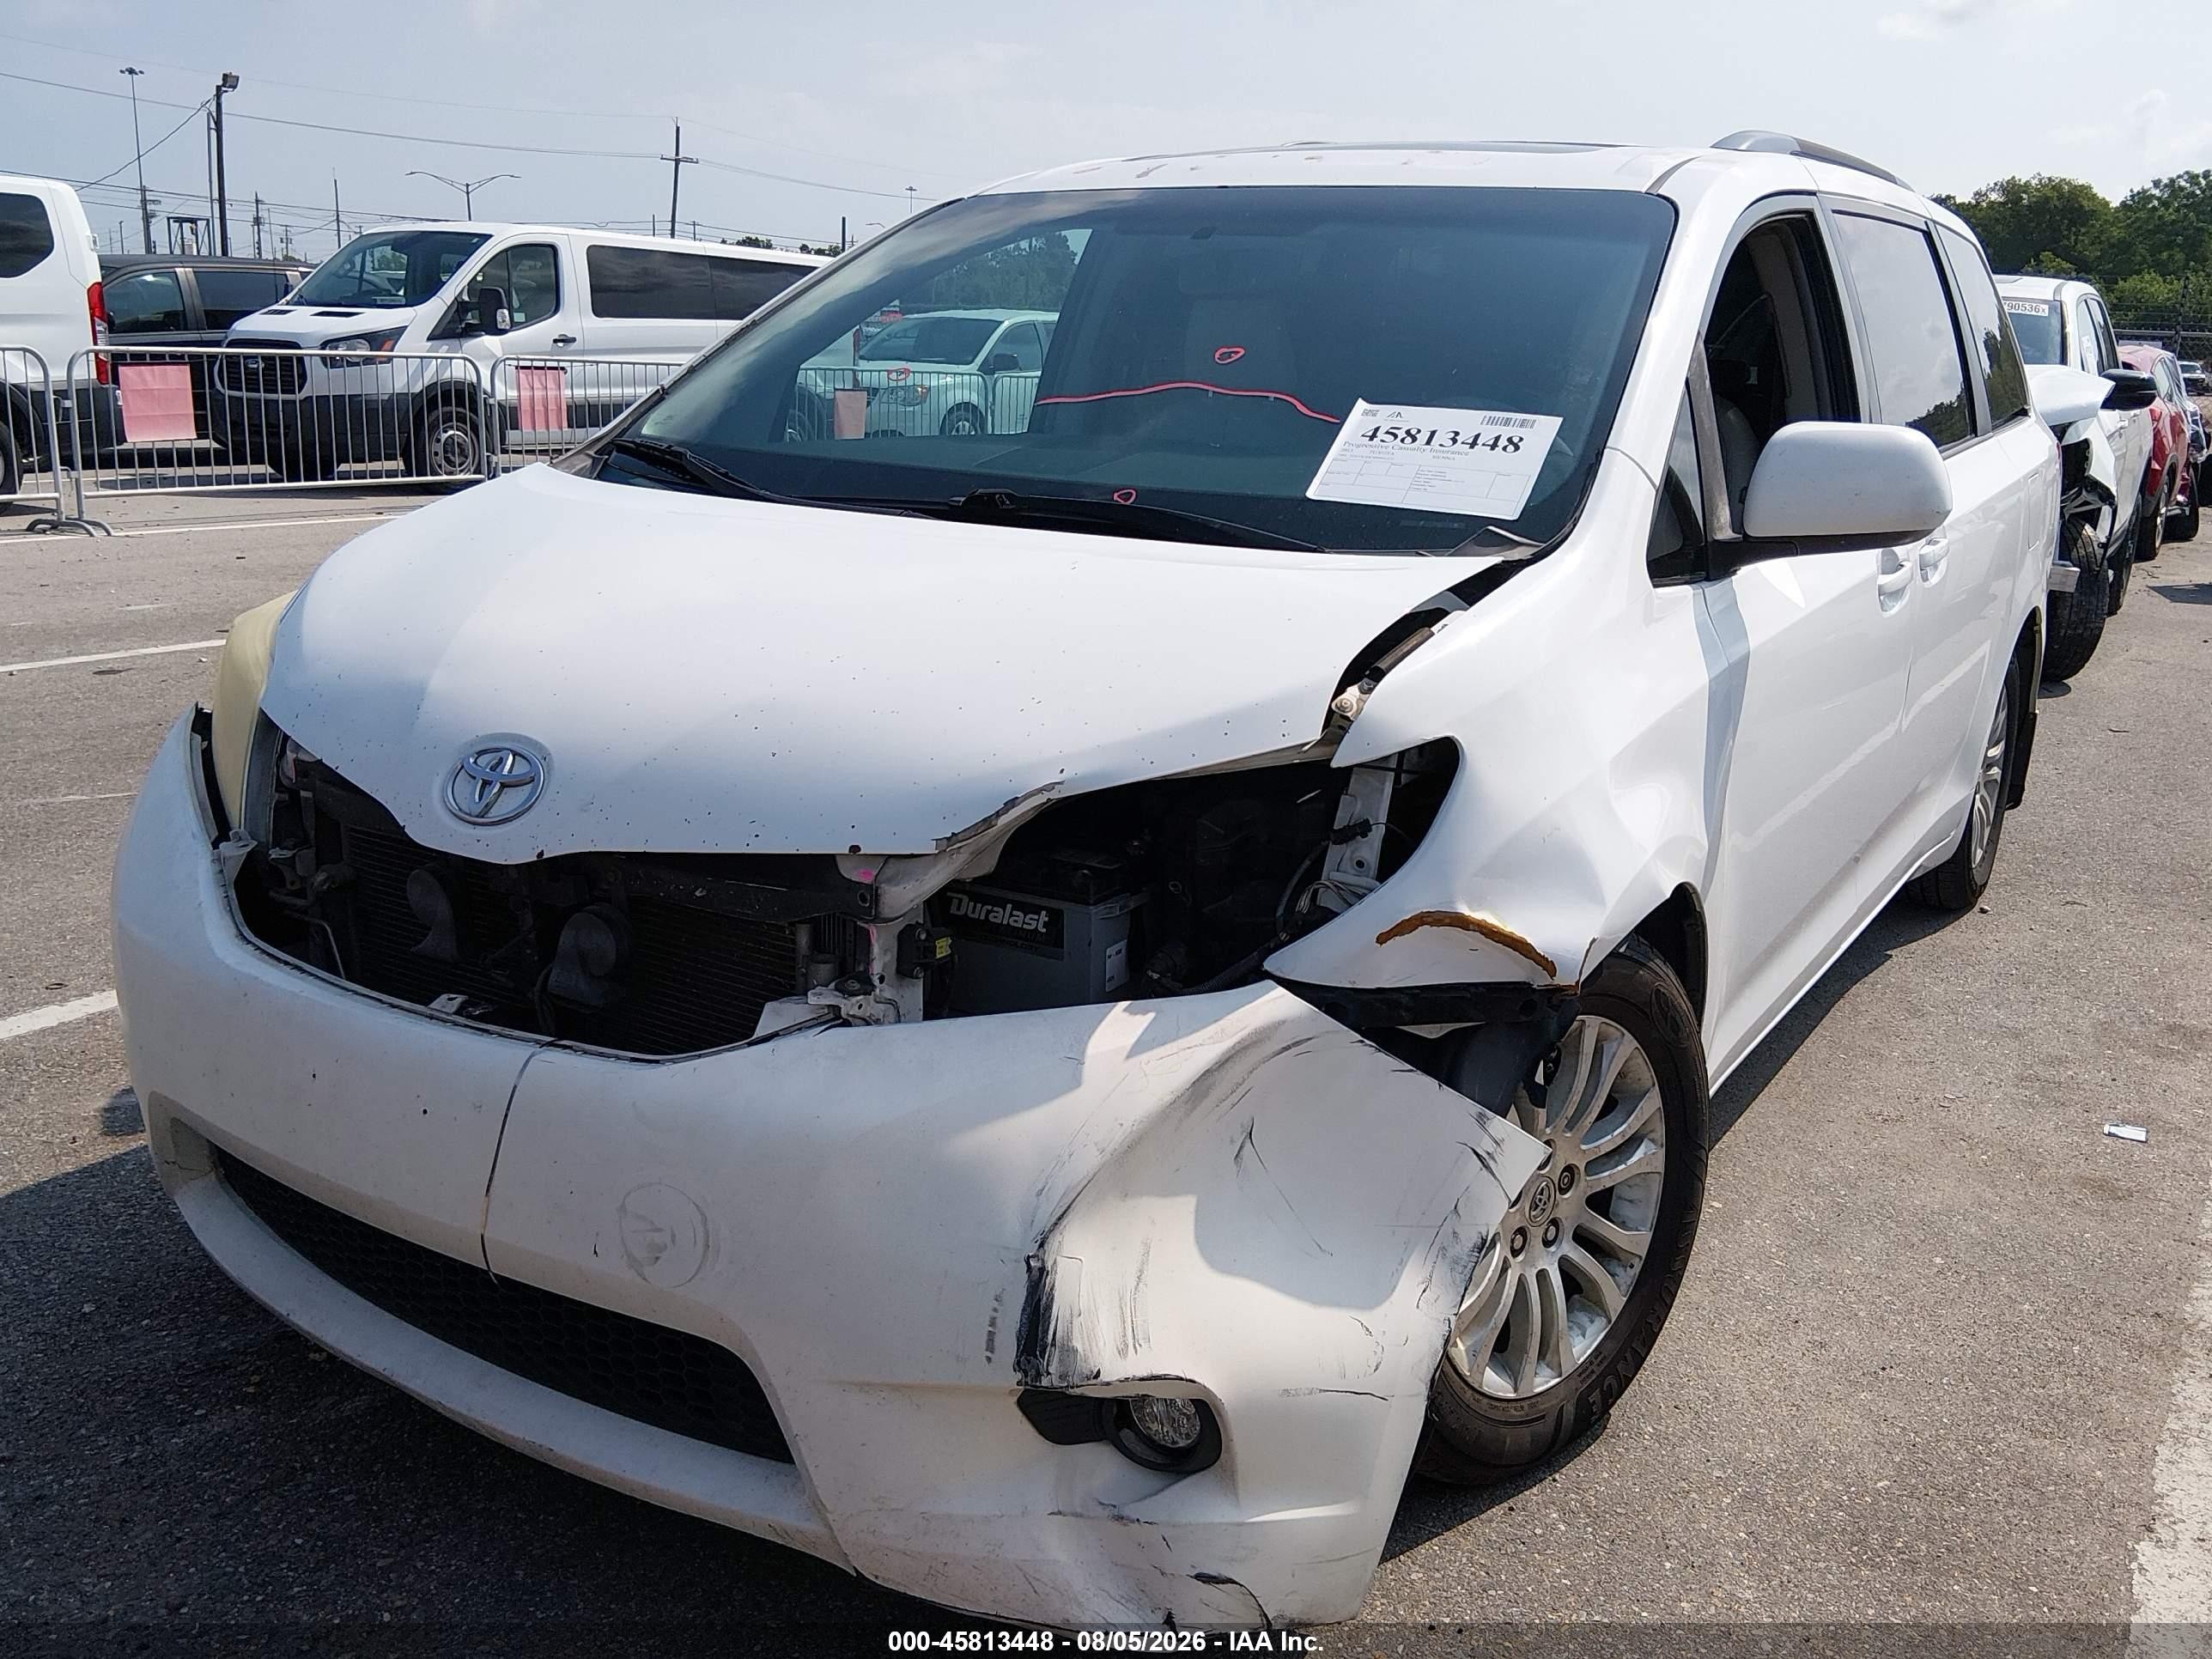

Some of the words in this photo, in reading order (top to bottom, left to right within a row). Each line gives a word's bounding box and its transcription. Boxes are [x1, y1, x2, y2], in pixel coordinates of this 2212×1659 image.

[1343, 441, 1390, 451] Progressive
[1391, 444, 1427, 454] Casualty
[1429, 447, 1469, 456] Insurance
[1360, 425, 1525, 454] 45813448
[946, 891, 1049, 933] Duralast
